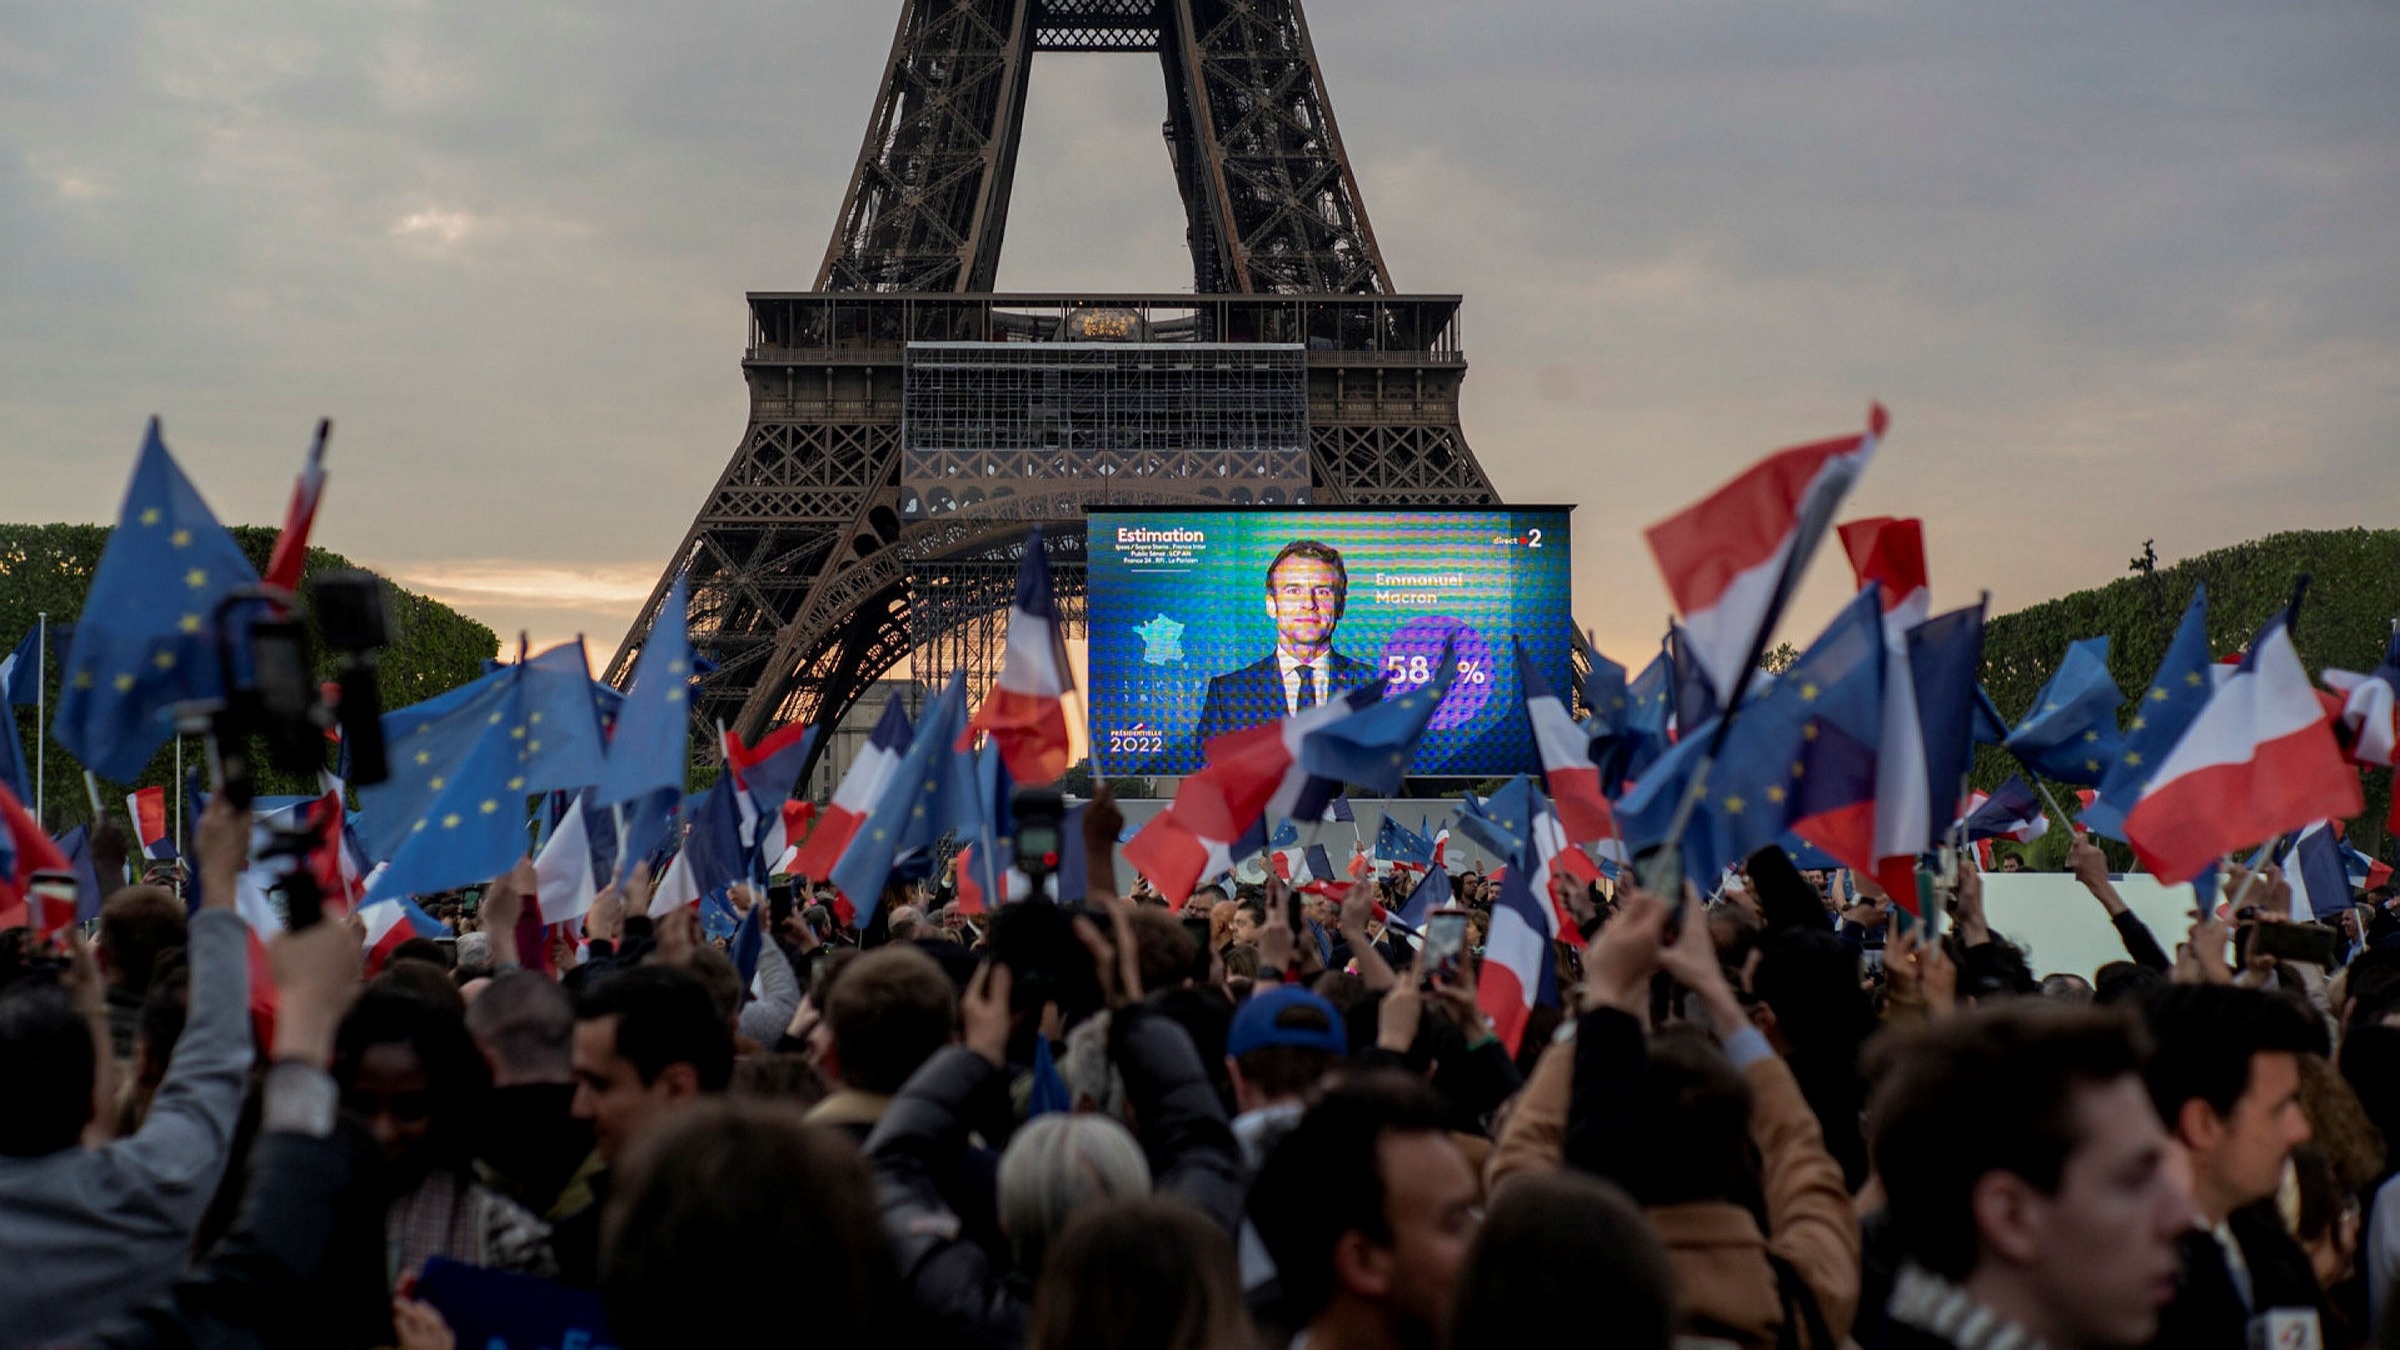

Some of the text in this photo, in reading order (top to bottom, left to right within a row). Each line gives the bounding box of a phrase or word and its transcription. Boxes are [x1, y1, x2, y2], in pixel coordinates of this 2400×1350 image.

[1118, 527, 1204, 542] Estimation
[1492, 528, 1542, 548] direct 2
[1376, 572, 1463, 586] Emmanuel
[1376, 591, 1438, 604] Macron
[1110, 737, 1162, 752] 2022
